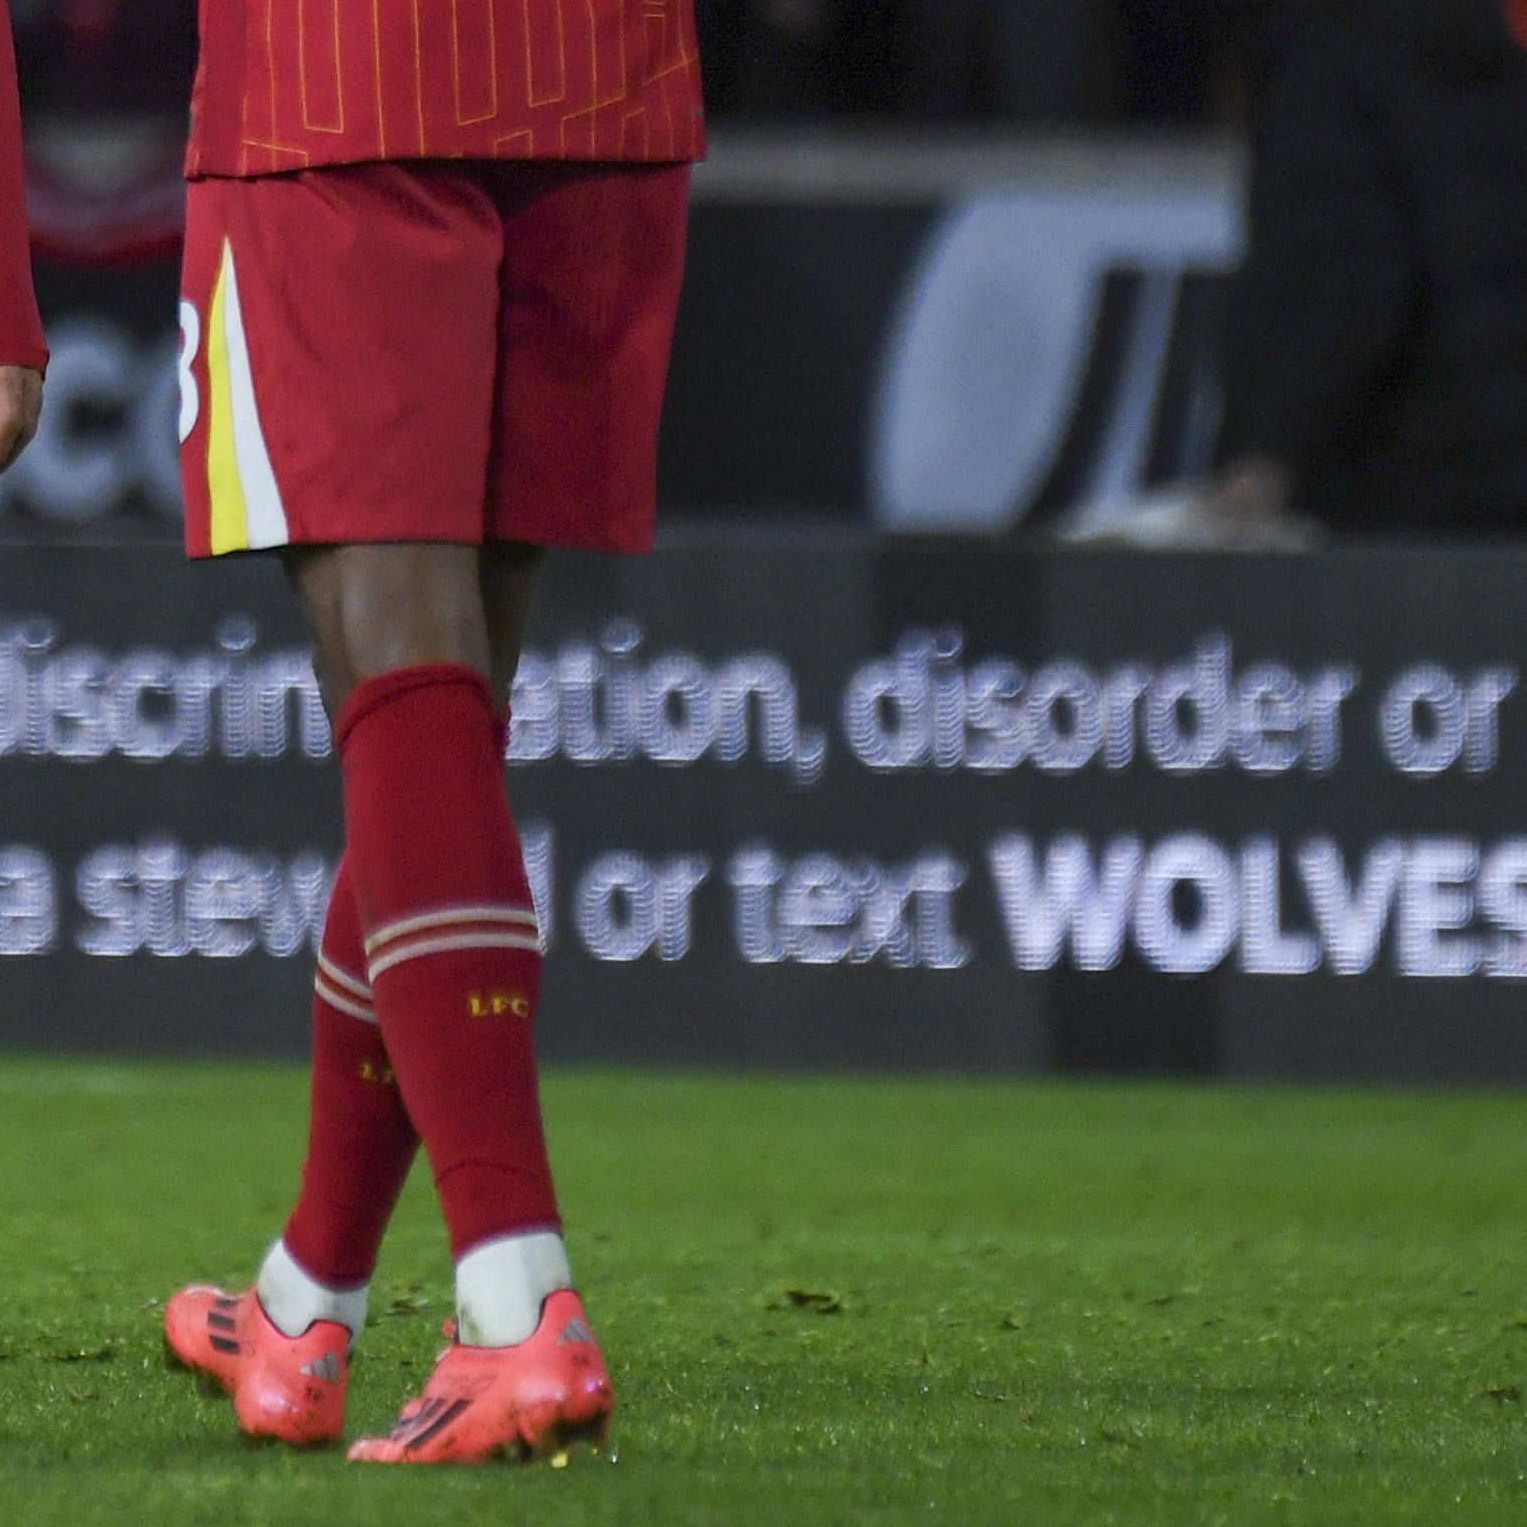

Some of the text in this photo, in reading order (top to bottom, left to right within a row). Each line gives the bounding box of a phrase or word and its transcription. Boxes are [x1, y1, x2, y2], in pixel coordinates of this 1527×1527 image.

[846, 625, 1356, 772] disorder
[1378, 659, 1518, 774] or
[578, 849, 712, 962] or
[729, 835, 973, 970] text
